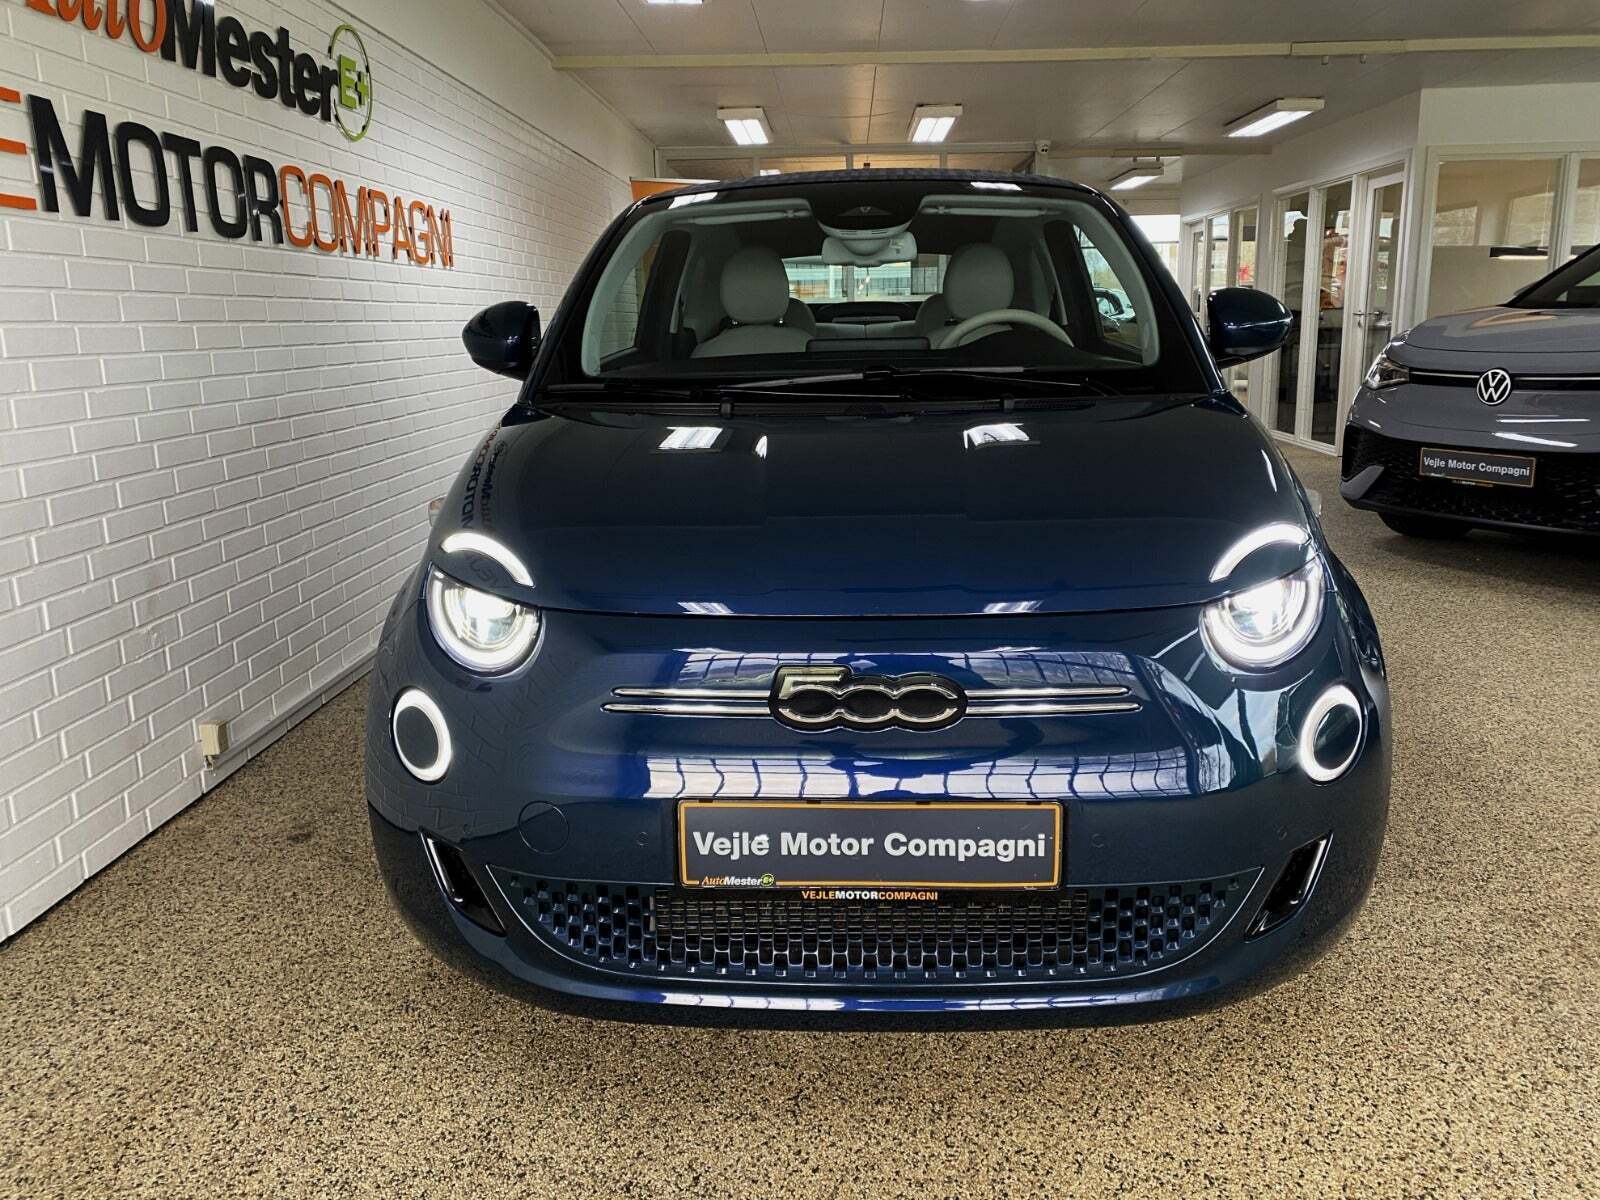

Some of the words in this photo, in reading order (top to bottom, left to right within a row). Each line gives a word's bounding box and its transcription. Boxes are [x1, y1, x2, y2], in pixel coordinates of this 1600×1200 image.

[27, 0, 338, 122] oMester
[1424, 457, 1446, 469] Vejle
[1447, 459, 1477, 471] Motor
[1478, 462, 1531, 477] Compagni
[777, 666, 958, 724] 500
[693, 831, 769, 860] Vejle
[780, 832, 874, 857] Motor
[884, 832, 1045, 862] Compagni
[702, 875, 762, 886] AutoMester
[801, 889, 939, 902] VEJLEMOTORCOMPAGNI
